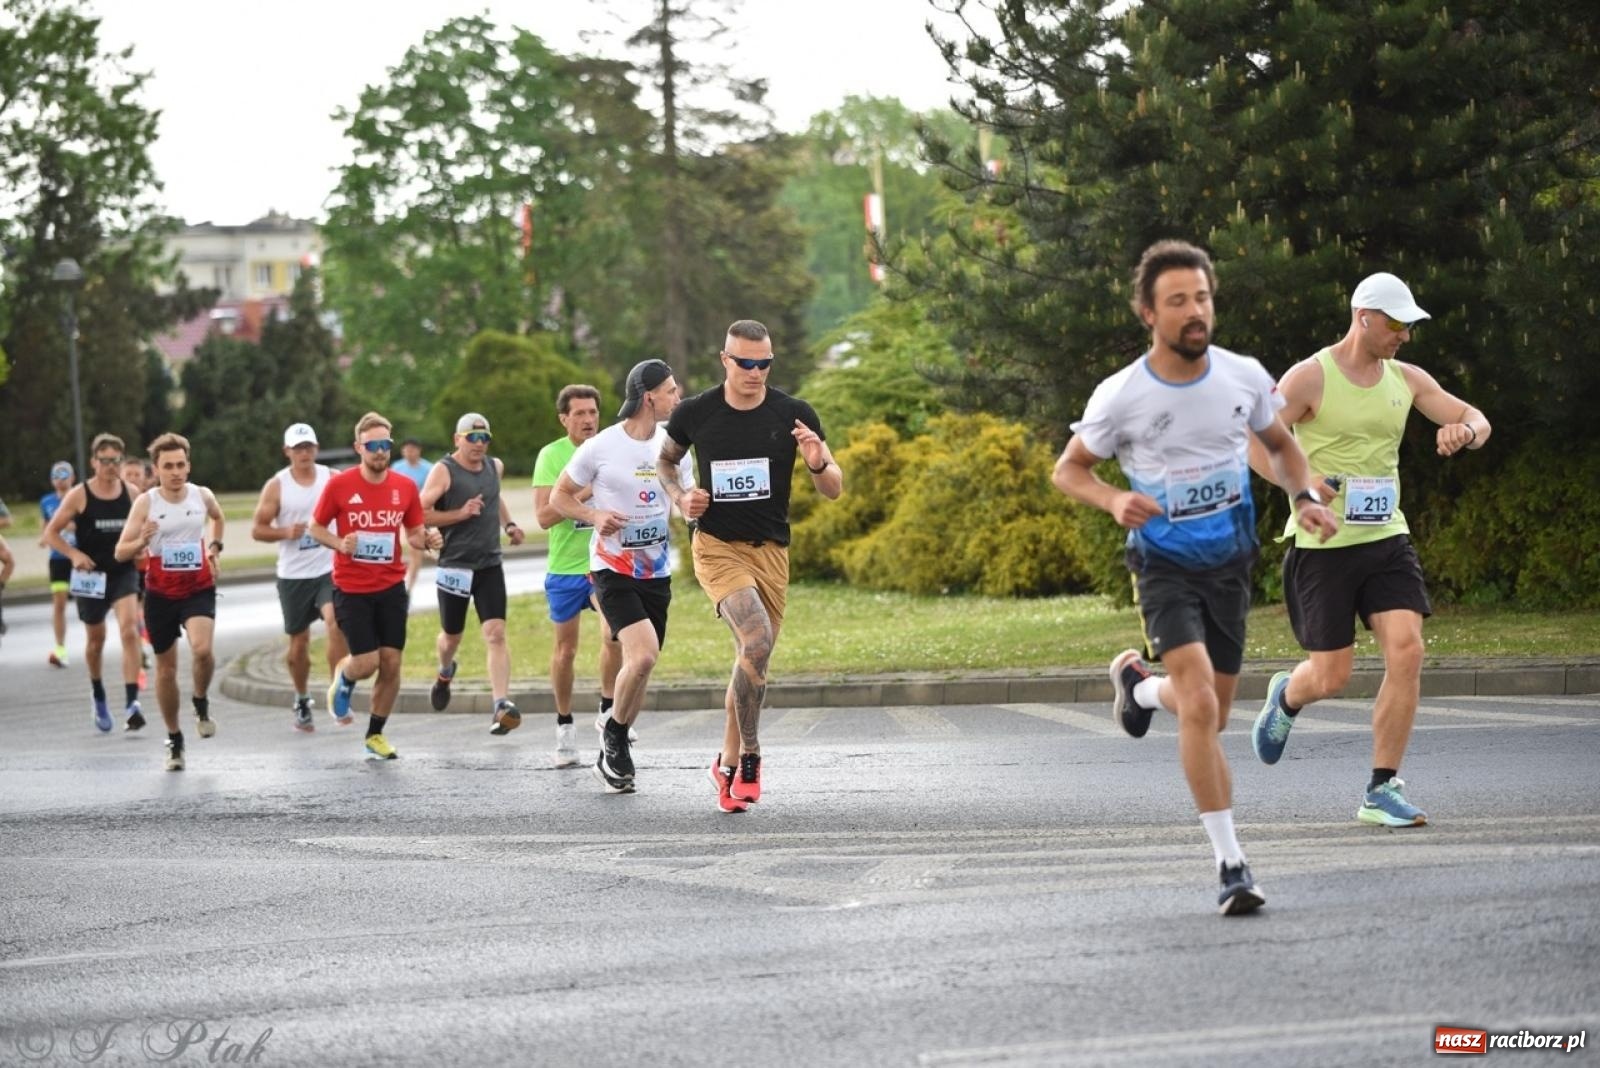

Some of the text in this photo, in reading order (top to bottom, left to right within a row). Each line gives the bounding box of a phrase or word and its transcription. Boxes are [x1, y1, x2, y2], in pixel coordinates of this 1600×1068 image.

[727, 475, 755, 490] 165
[1186, 481, 1226, 505] 205
[1364, 496, 1388, 512] 213
[348, 510, 404, 528] POLSKA
[635, 527, 658, 540] 162
[365, 544, 384, 554] 174
[173, 551, 195, 562] 190
[444, 574, 460, 587] 191
